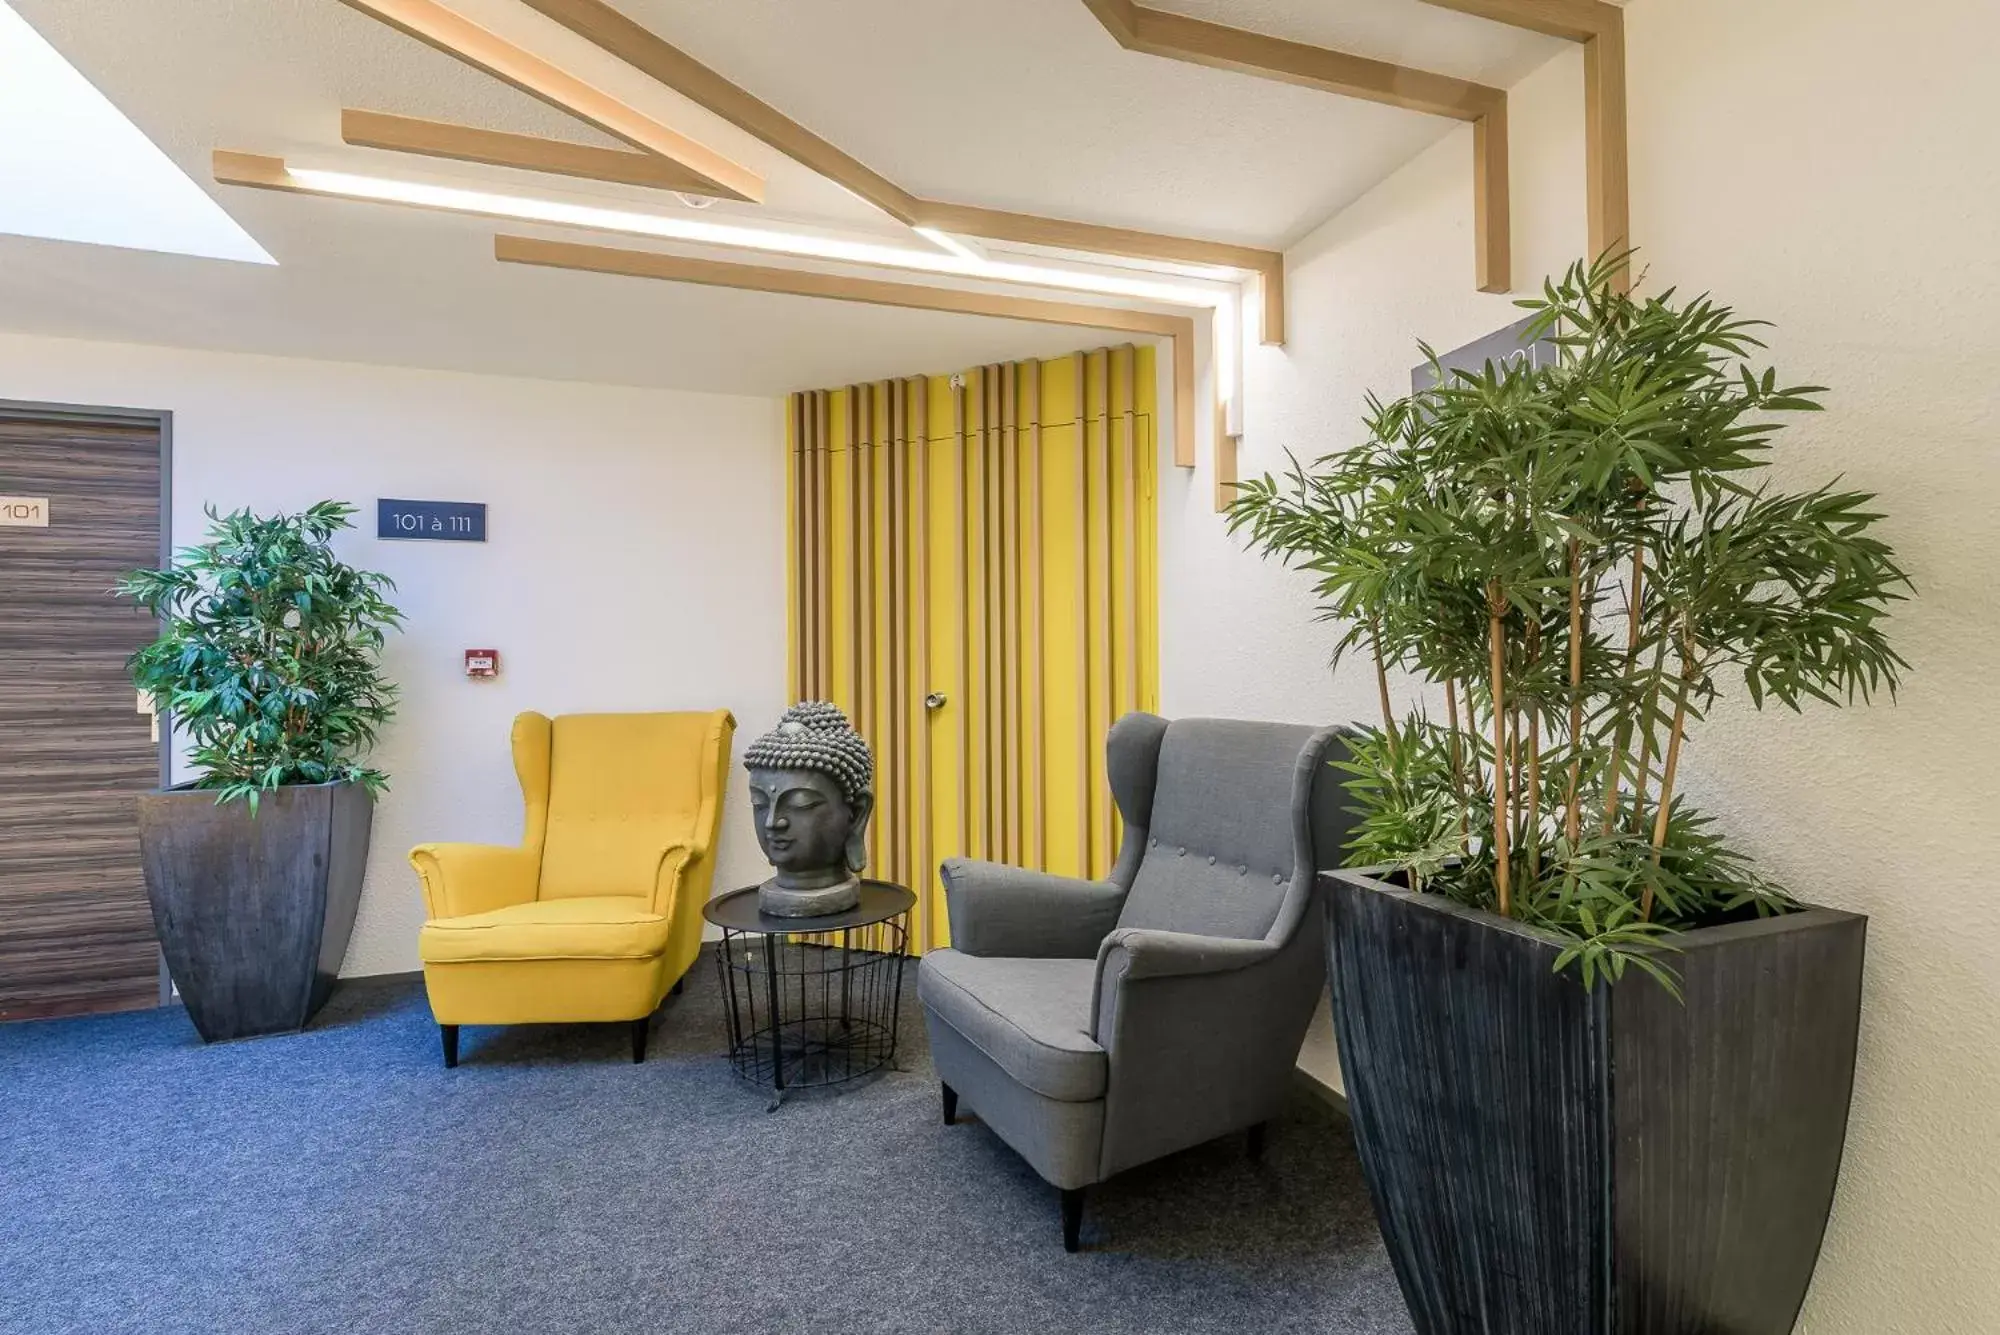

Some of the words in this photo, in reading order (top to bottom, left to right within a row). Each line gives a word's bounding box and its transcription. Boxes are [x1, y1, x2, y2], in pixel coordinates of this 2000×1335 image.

[3, 505, 39, 518] 101
[393, 513, 424, 530] 101
[431, 516, 442, 531] à
[449, 516, 471, 532] 111
